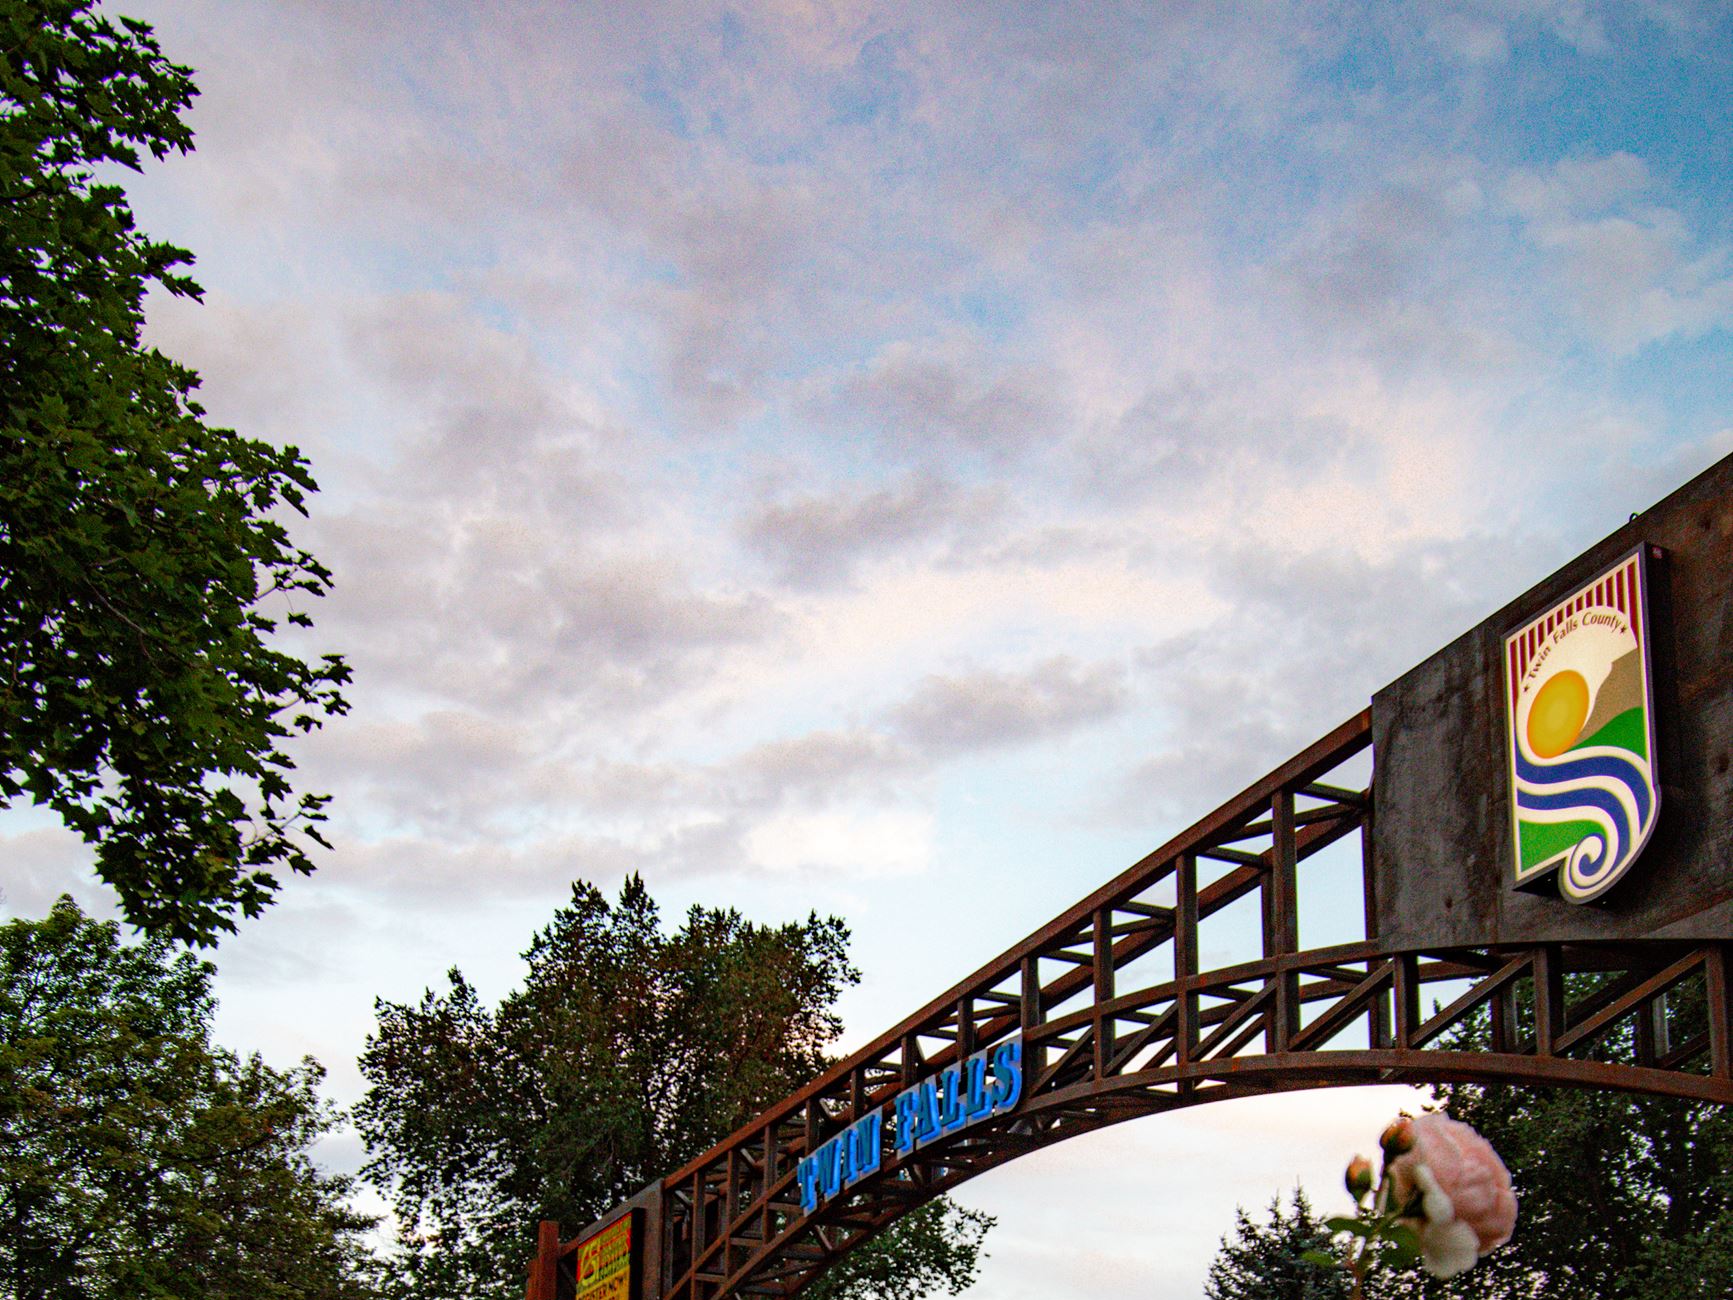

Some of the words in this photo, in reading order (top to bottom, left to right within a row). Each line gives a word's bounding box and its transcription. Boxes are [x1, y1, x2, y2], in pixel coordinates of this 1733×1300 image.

[1528, 645, 1551, 679] Twin
[1552, 618, 1578, 644] Falls
[1582, 611, 1621, 633] County
[797, 1113, 881, 1211] TWIN
[895, 1043, 1022, 1152] FALLS
